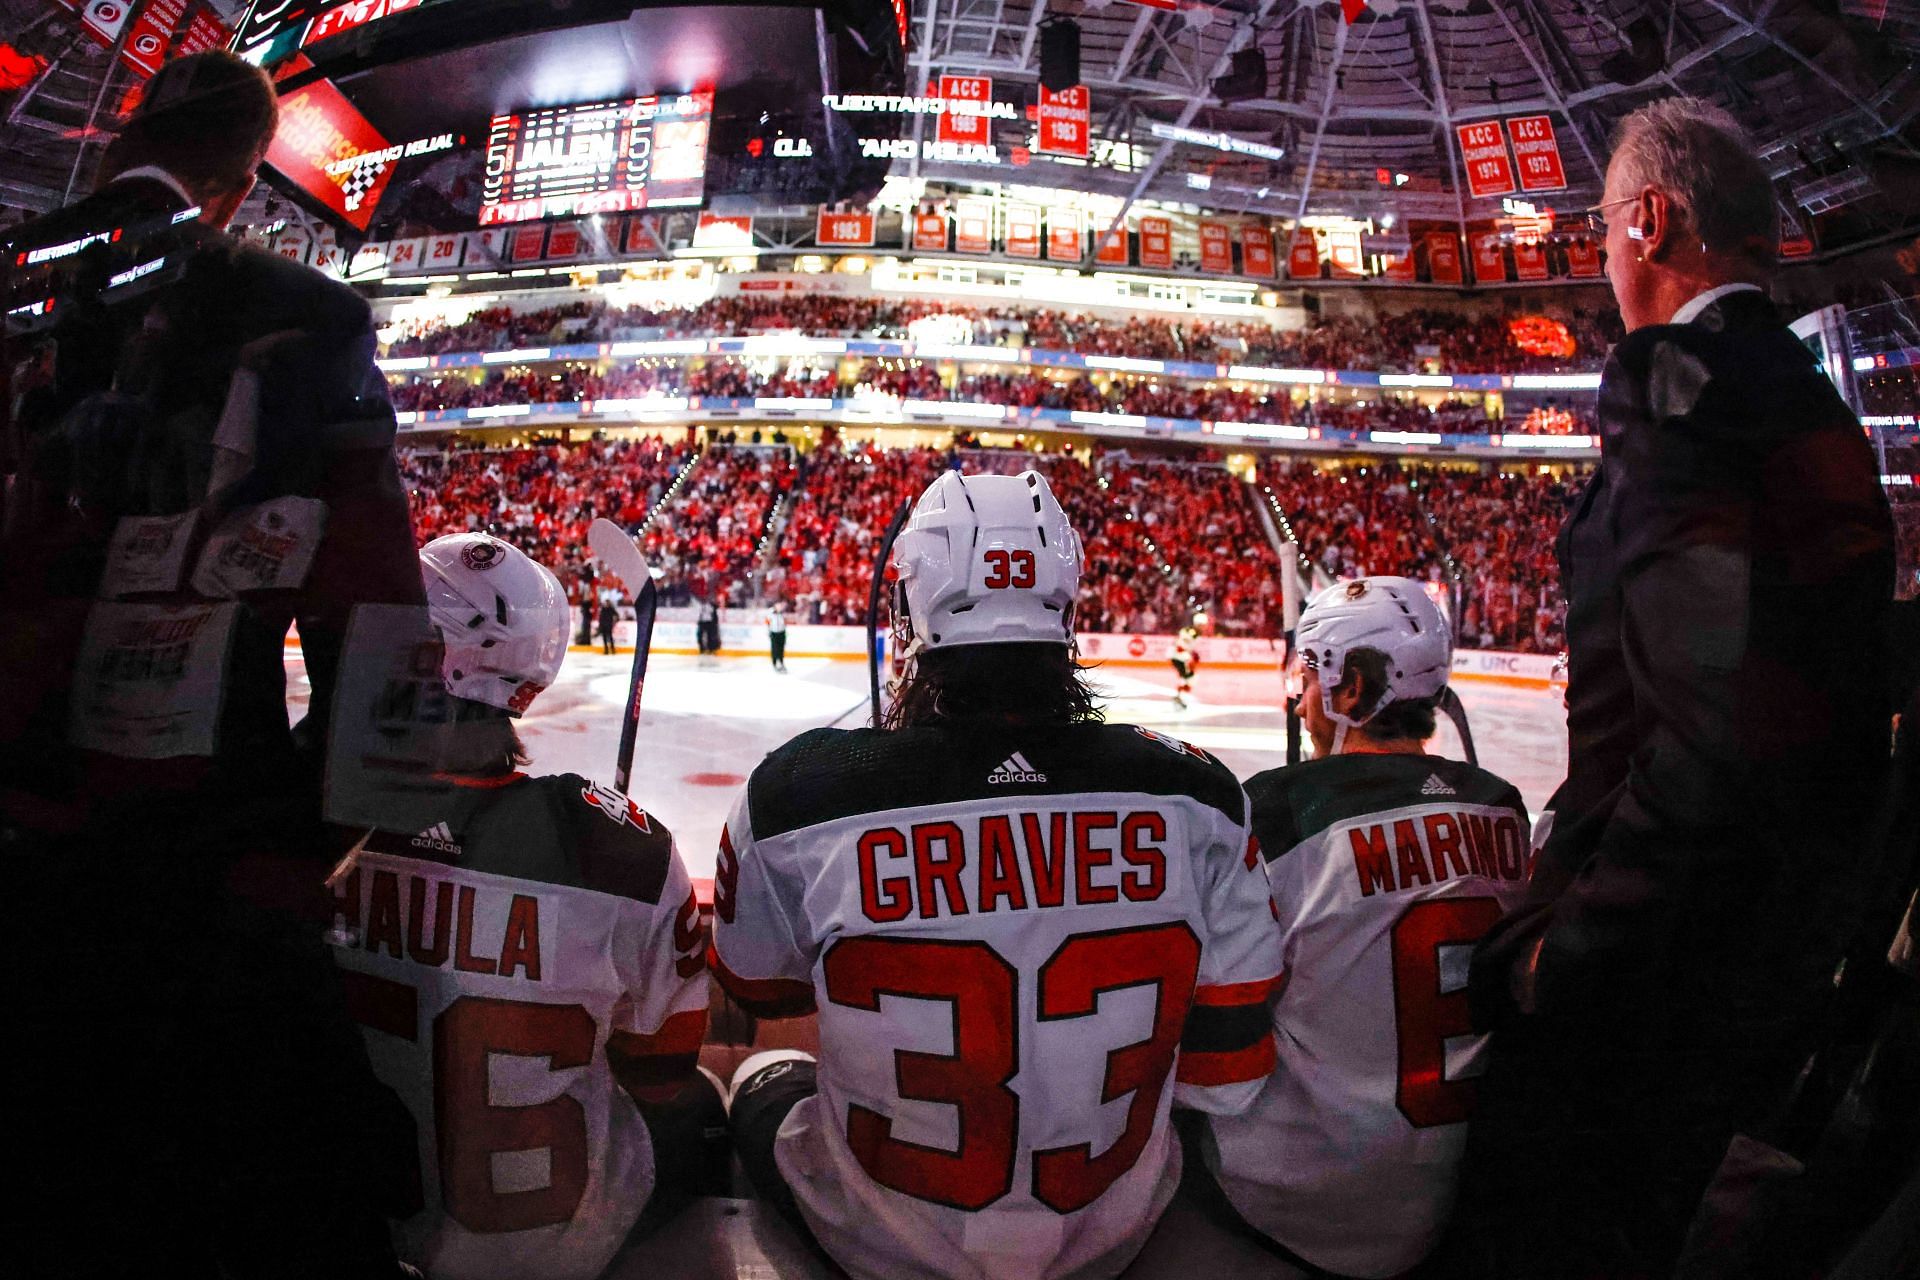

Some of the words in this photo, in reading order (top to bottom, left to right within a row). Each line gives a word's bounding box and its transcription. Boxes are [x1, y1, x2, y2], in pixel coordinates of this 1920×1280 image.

[143, 12, 173, 38] CHAMPIONS
[151, 4, 176, 26] DIVISION
[951, 80, 980, 97] ACC
[284, 90, 359, 161] Advance
[1051, 123, 1077, 141] 1983
[1468, 126, 1493, 145] ACC
[1518, 121, 1543, 138] ACC
[516, 132, 615, 171] JALEN
[629, 127, 651, 159] 5
[486, 144, 507, 177] 5
[1477, 161, 1500, 179] 1974
[1528, 156, 1551, 173] 1973
[395, 242, 413, 261] 24
[433, 239, 454, 258] 20
[984, 549, 1036, 589] 33
[988, 770, 1047, 784] adidas
[1421, 785, 1456, 795] adidas
[411, 835, 462, 855] adidas
[1348, 811, 1526, 897] MARINO
[857, 811, 1167, 923] GRAVES
[330, 860, 542, 982] HAULA
[822, 920, 1203, 1215] 33
